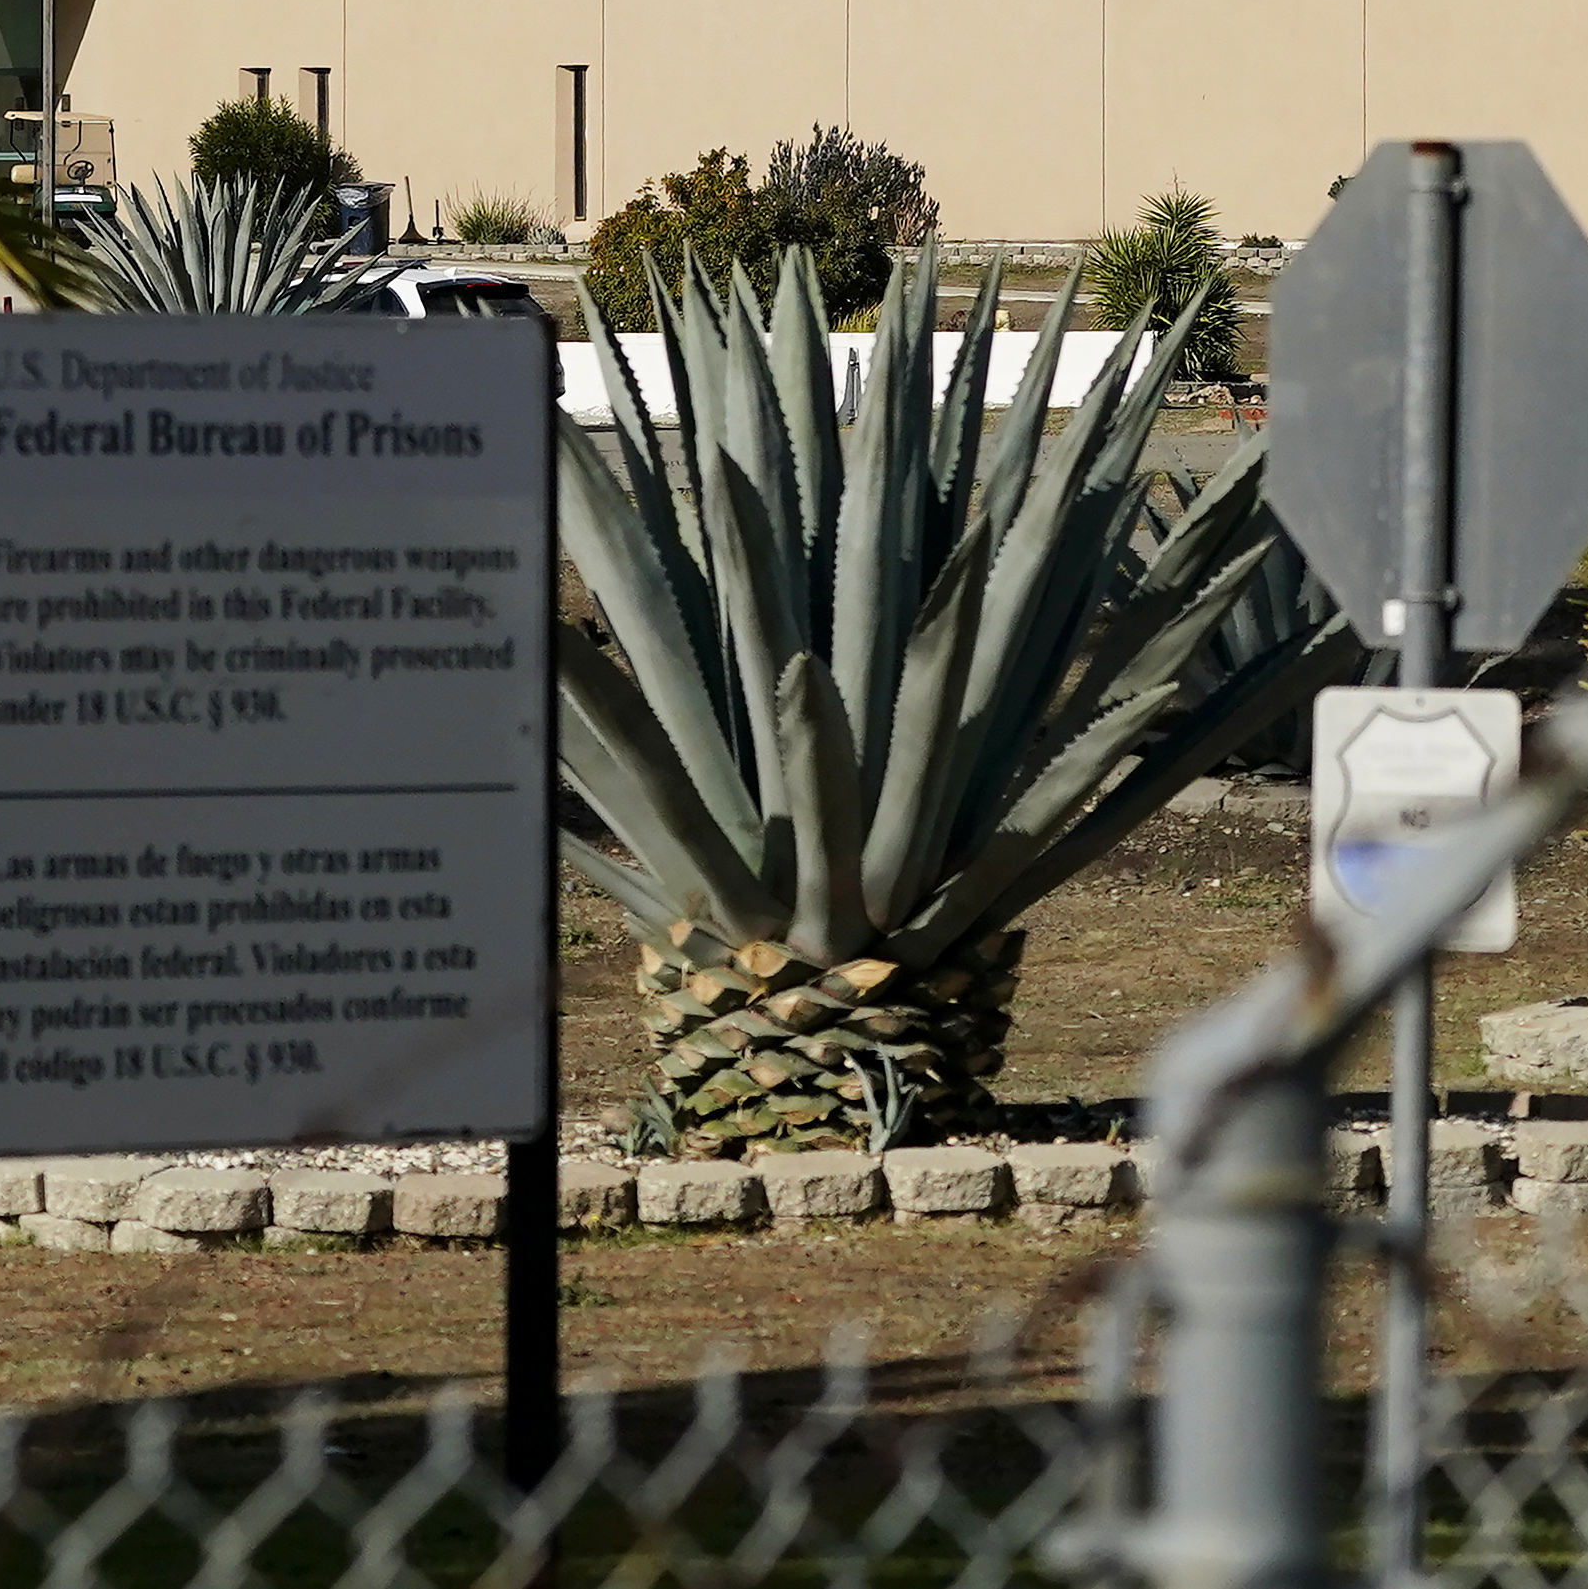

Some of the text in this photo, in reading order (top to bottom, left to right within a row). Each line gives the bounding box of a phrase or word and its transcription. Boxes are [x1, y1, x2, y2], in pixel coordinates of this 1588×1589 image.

[60, 349, 230, 401] Department
[237, 349, 269, 391] of
[278, 351, 374, 393] Justice
[146, 409, 286, 458] Bureau
[295, 410, 337, 458] of
[343, 407, 484, 459] Prisons
[120, 538, 171, 574] and
[178, 538, 251, 574] other
[256, 538, 398, 581] dangerous
[403, 544, 520, 580] weapons
[35, 588, 181, 631] prohibited
[187, 588, 216, 623] in
[223, 588, 270, 622] this
[279, 587, 384, 622] Federal
[119, 643, 178, 680] may
[185, 640, 218, 673] be
[370, 638, 516, 680] prosecuted
[113, 691, 203, 725] U.S.C.
[43, 849, 129, 881] armas
[136, 845, 169, 879] de
[177, 843, 251, 885] fuego
[255, 851, 272, 885] y
[280, 847, 350, 876] otras
[358, 846, 441, 873] armas
[206, 889, 352, 934] prohibidas
[360, 897, 392, 923] en
[399, 893, 452, 921] esta
[139, 944, 243, 979] federal.
[252, 941, 395, 975] Violadores
[402, 947, 417, 972] a
[424, 943, 478, 972] esta
[138, 997, 179, 1027] ser
[186, 990, 334, 1035] procesados
[342, 987, 470, 1022] conforme
[115, 1046, 145, 1080] 18
[152, 1041, 236, 1080] U.S.C.
